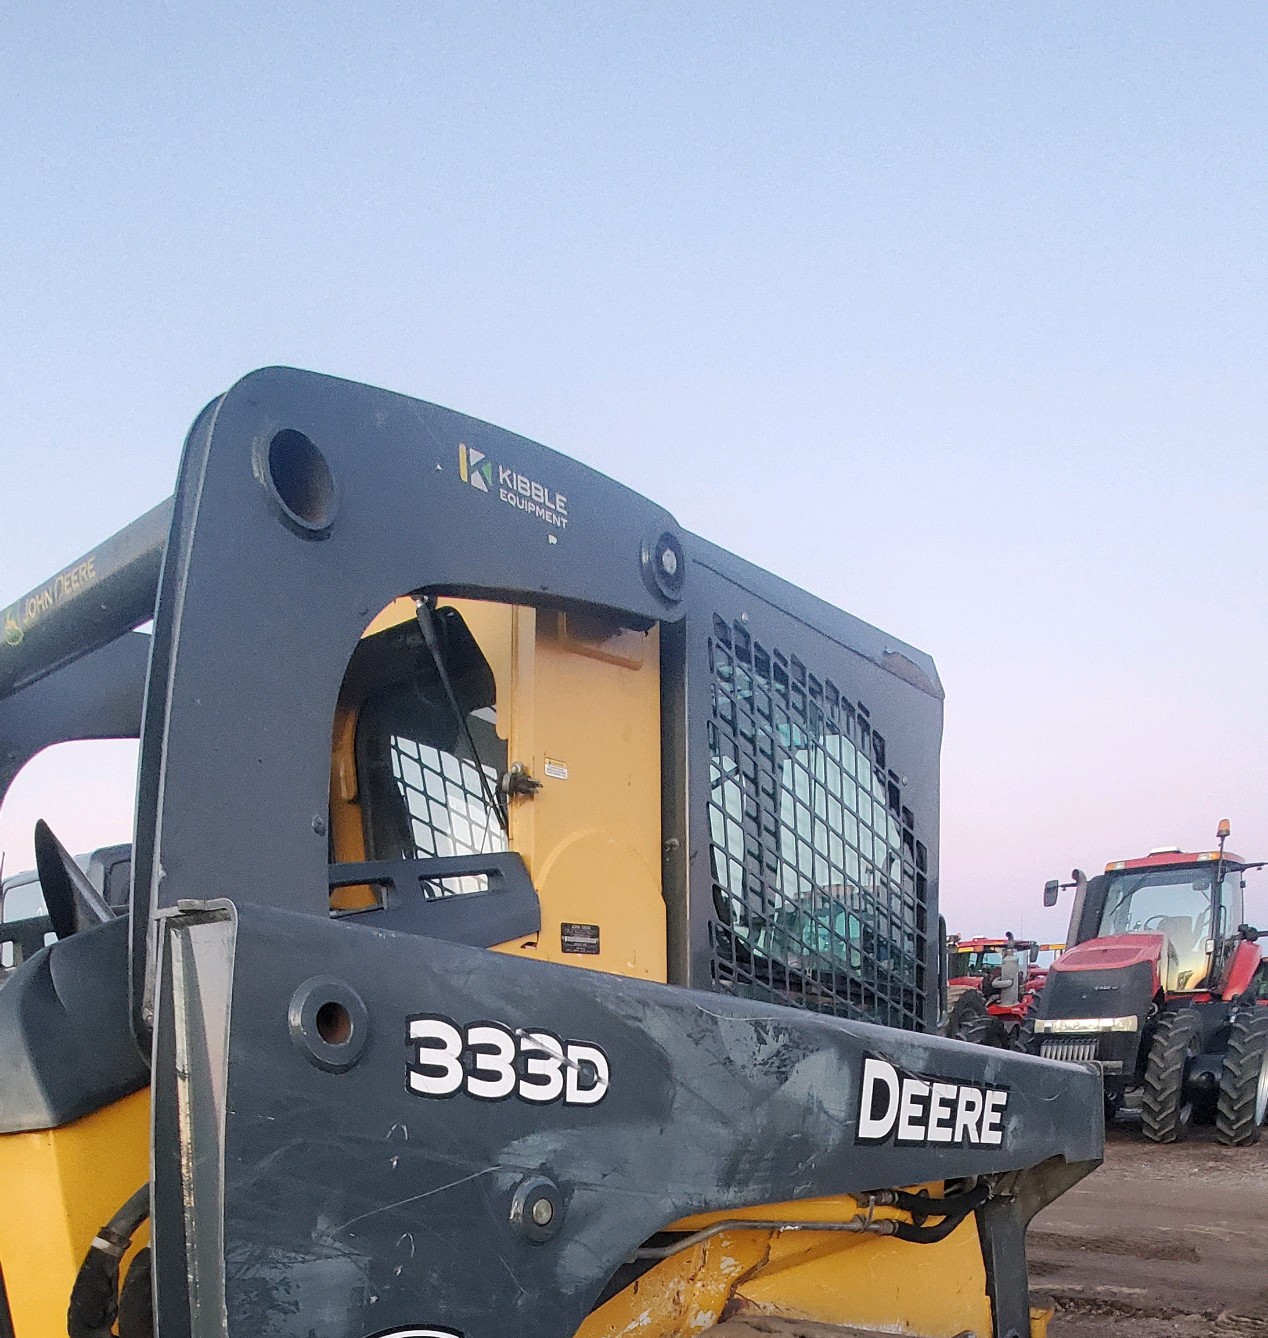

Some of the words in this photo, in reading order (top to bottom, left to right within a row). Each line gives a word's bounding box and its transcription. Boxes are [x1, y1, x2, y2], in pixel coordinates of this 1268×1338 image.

[499, 465, 567, 515] KIBBLE
[500, 488, 567, 528] EQUIPMENT
[23, 585, 53, 624] JOHN
[55, 556, 96, 601] DEERE
[409, 1019, 609, 1104] 333D
[858, 1058, 1008, 1144] DEERE
